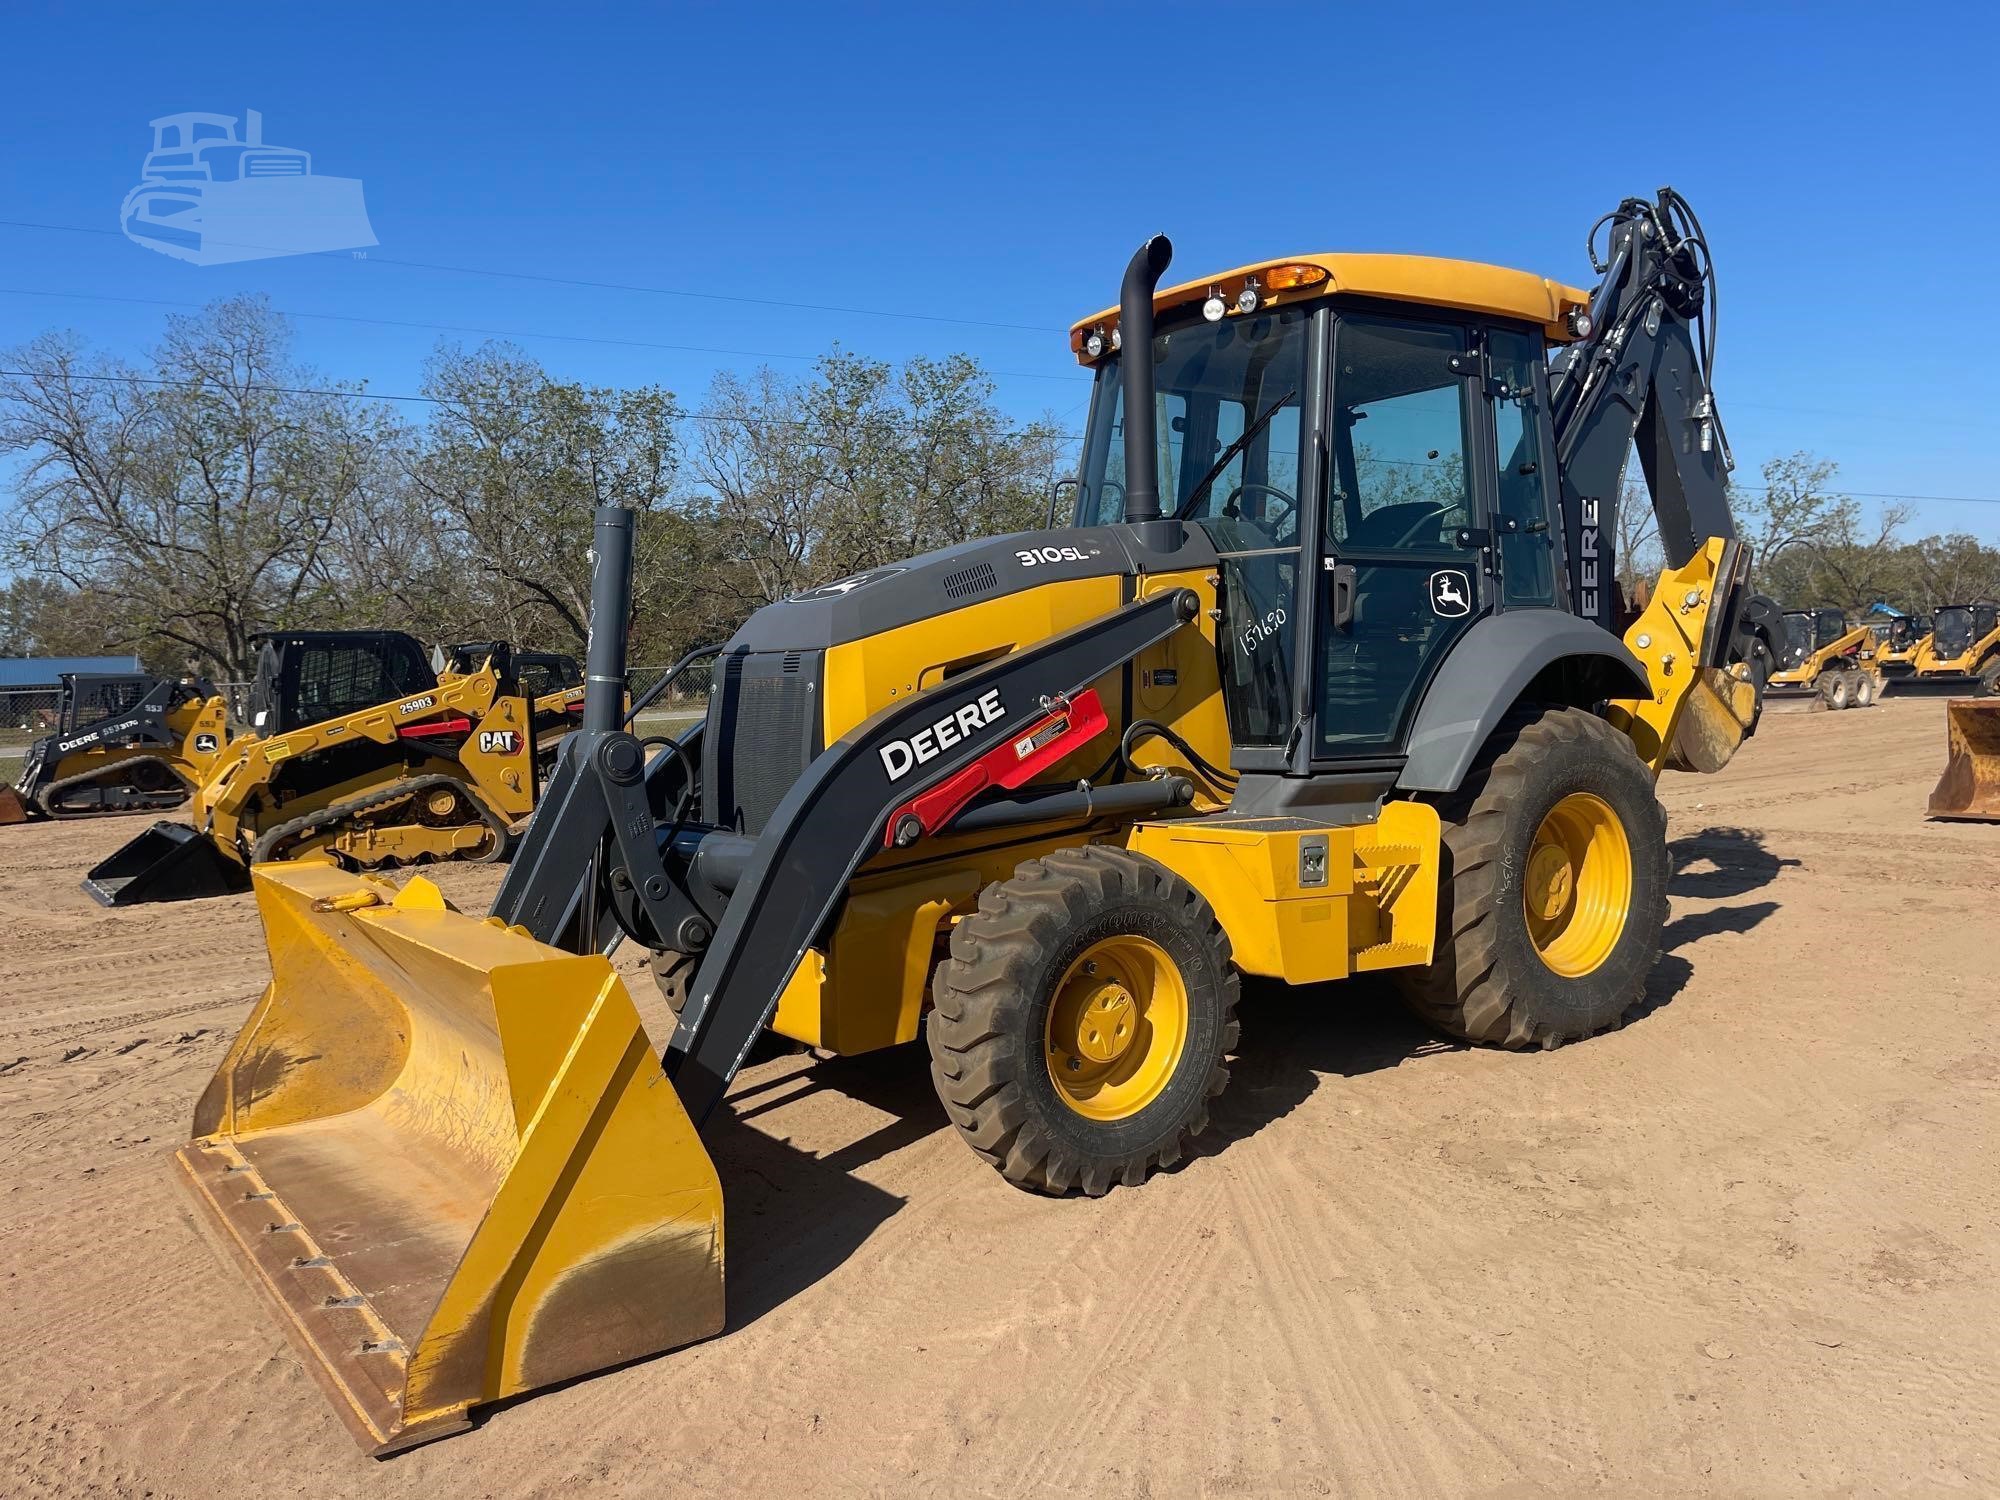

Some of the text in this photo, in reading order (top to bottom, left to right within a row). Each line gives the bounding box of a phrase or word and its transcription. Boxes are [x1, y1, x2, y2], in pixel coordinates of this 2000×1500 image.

[1015, 546, 1090, 567] 310SL
[1581, 499, 1599, 617] EERE
[399, 697, 433, 715] 259D3
[58, 731, 100, 752] DEERE
[480, 731, 514, 753] CAT
[879, 688, 1006, 782] DEERE
